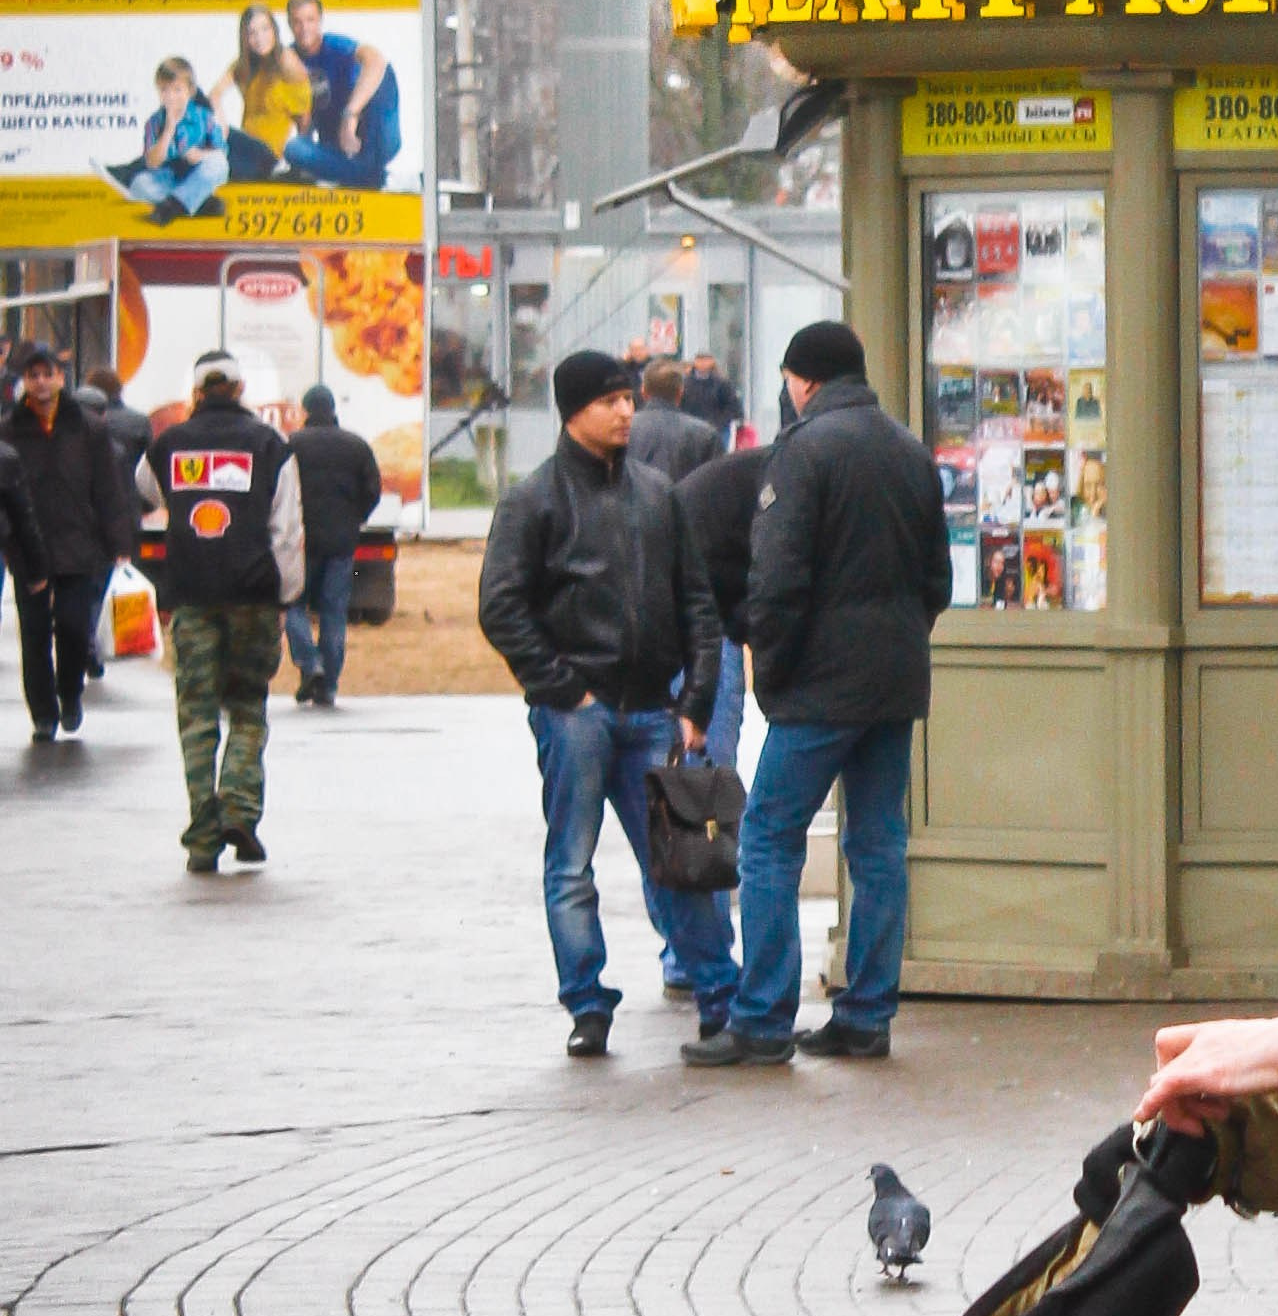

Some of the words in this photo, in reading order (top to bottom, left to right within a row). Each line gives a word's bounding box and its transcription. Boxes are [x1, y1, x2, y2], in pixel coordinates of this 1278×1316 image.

[2, 92, 129, 109] ПРЕДЛОЖЕНИЕ
[926, 99, 1015, 127] 380-80-50
[0, 115, 48, 130] ШЕГО
[52, 114, 138, 129] КАЧЕСТВА
